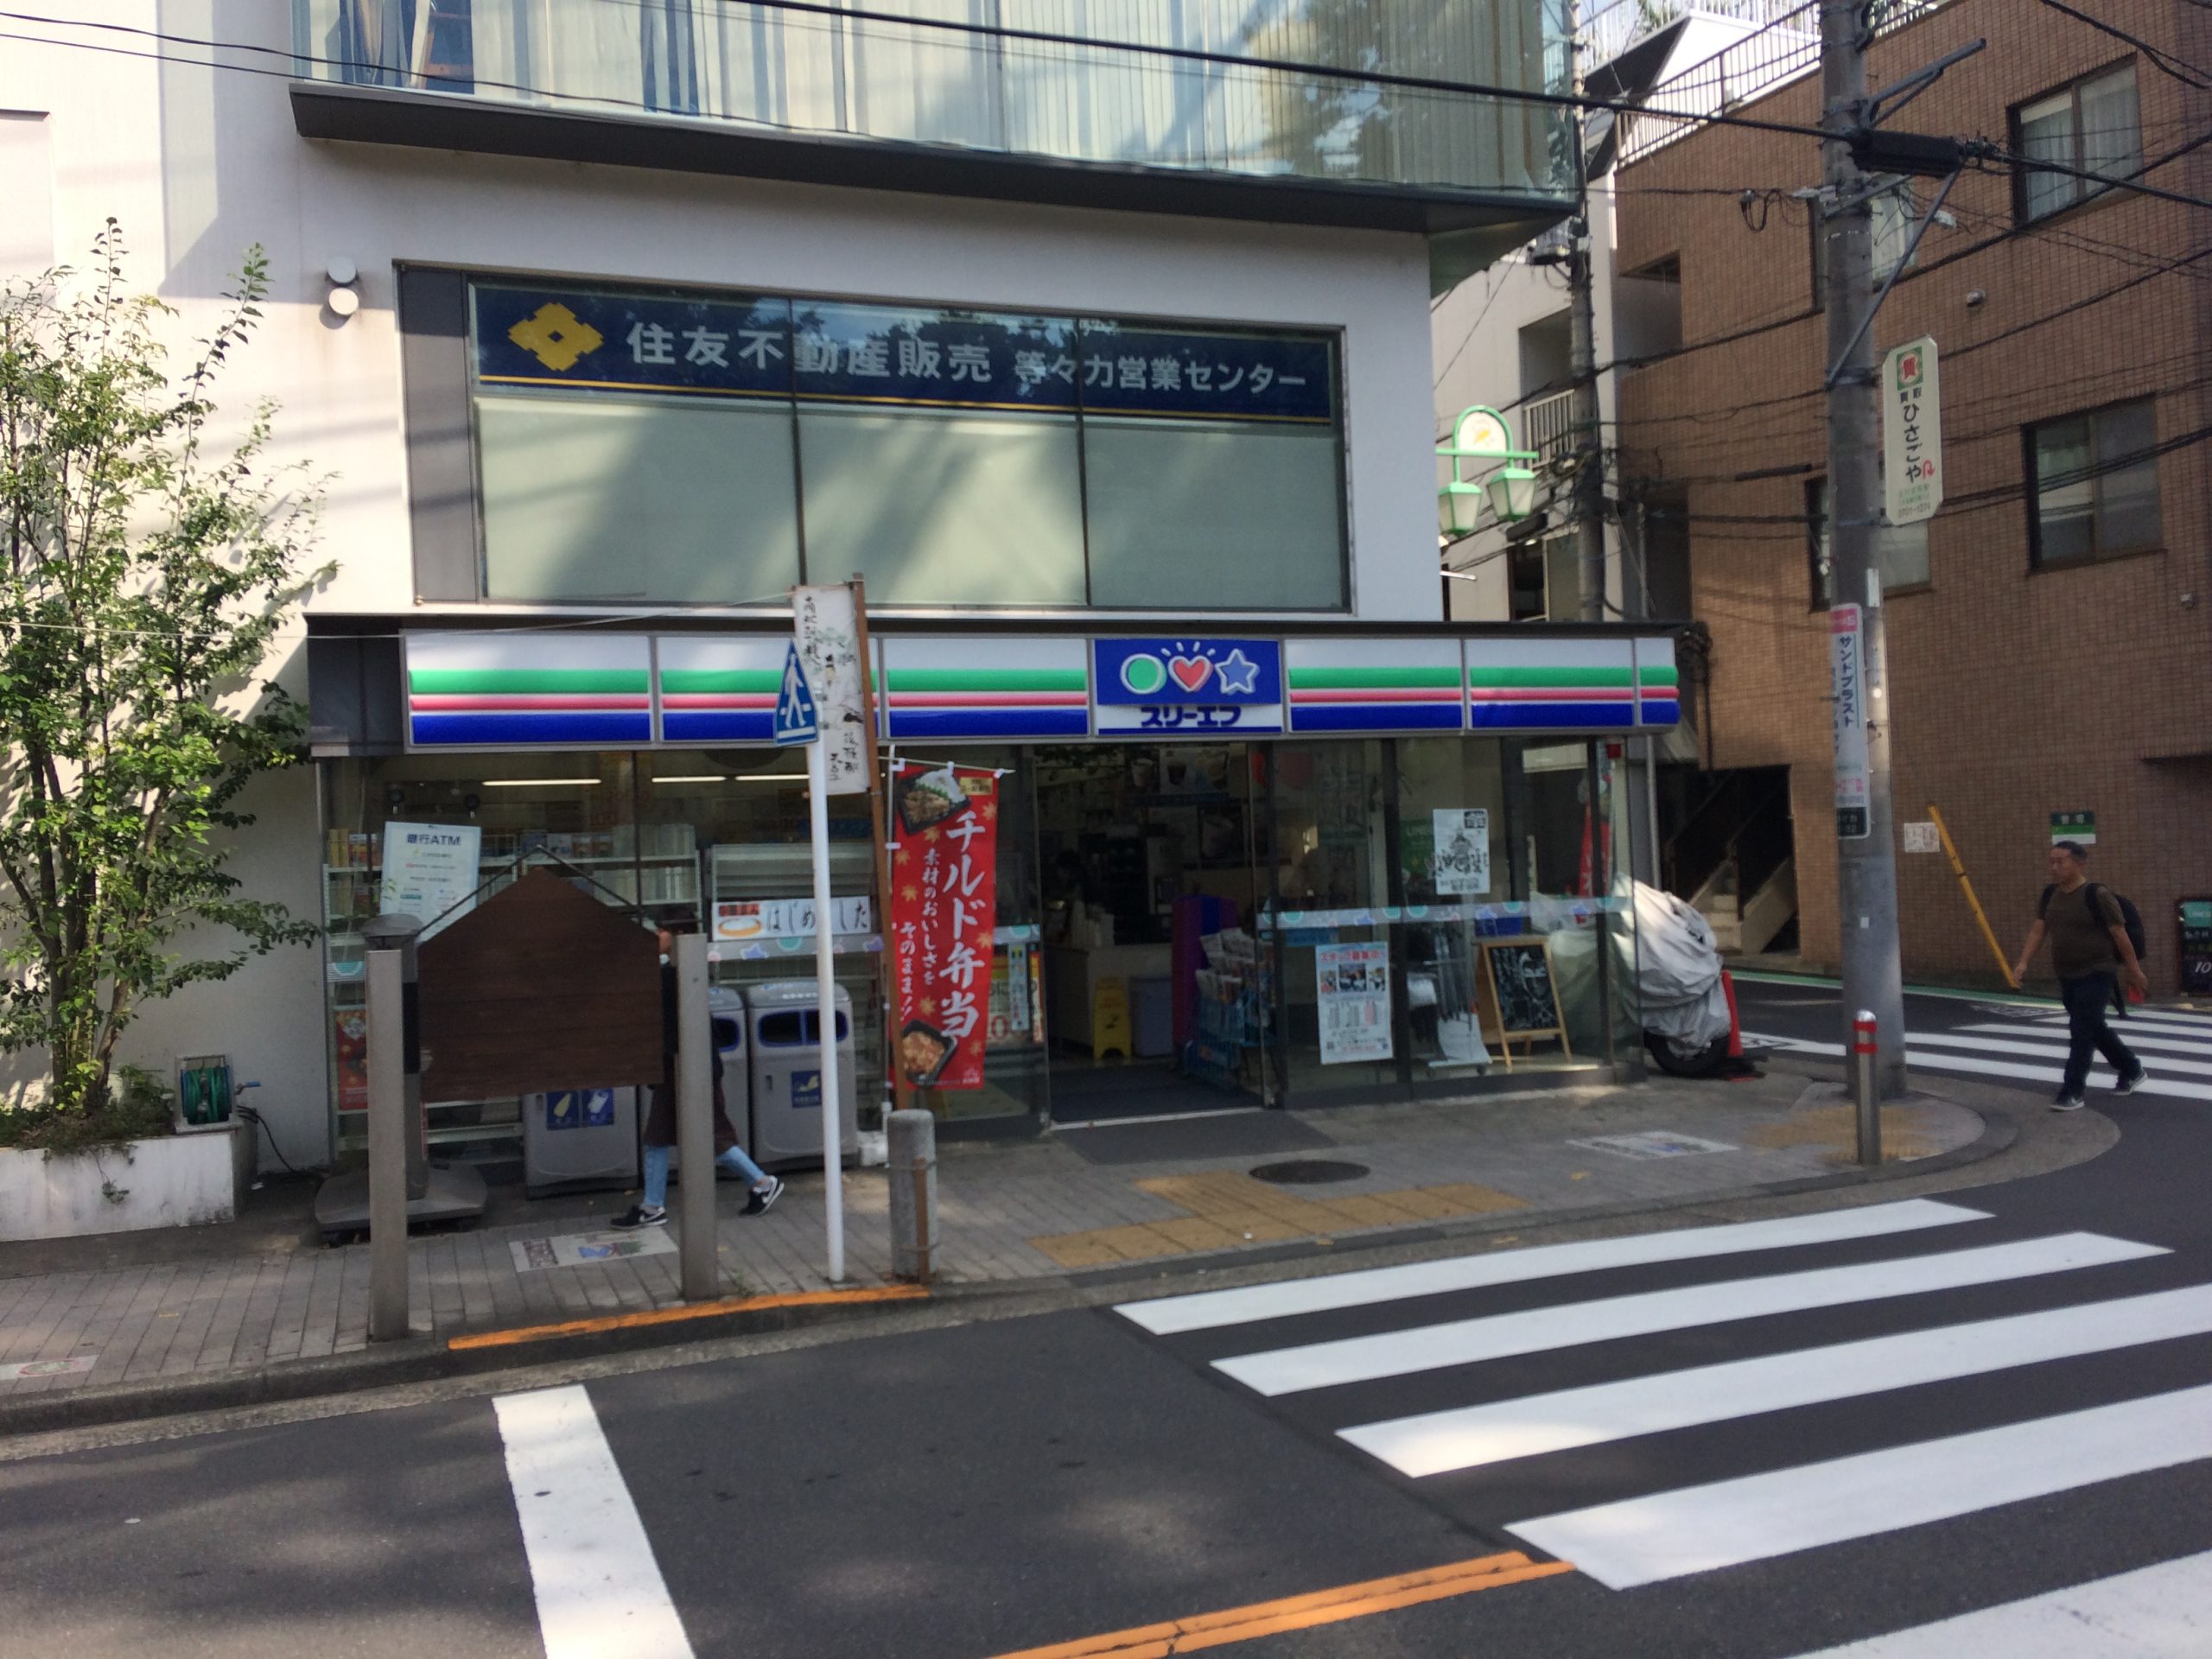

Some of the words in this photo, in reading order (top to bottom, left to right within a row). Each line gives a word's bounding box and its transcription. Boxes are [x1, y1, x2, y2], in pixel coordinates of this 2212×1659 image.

[626, 321, 993, 383] 住友不動産販売
[1014, 349, 1306, 395] 等々力営業センター
[1904, 403, 1923, 484] ひさごや
[1141, 705, 1242, 728] スリーエフ
[1839, 635, 1855, 728] サンドブラスト
[406, 833, 461, 846] 銀行ATM
[766, 899, 868, 934] はじめした
[921, 847, 940, 986] 素材のおいしさを
[938, 809, 988, 1038] チルド弁当
